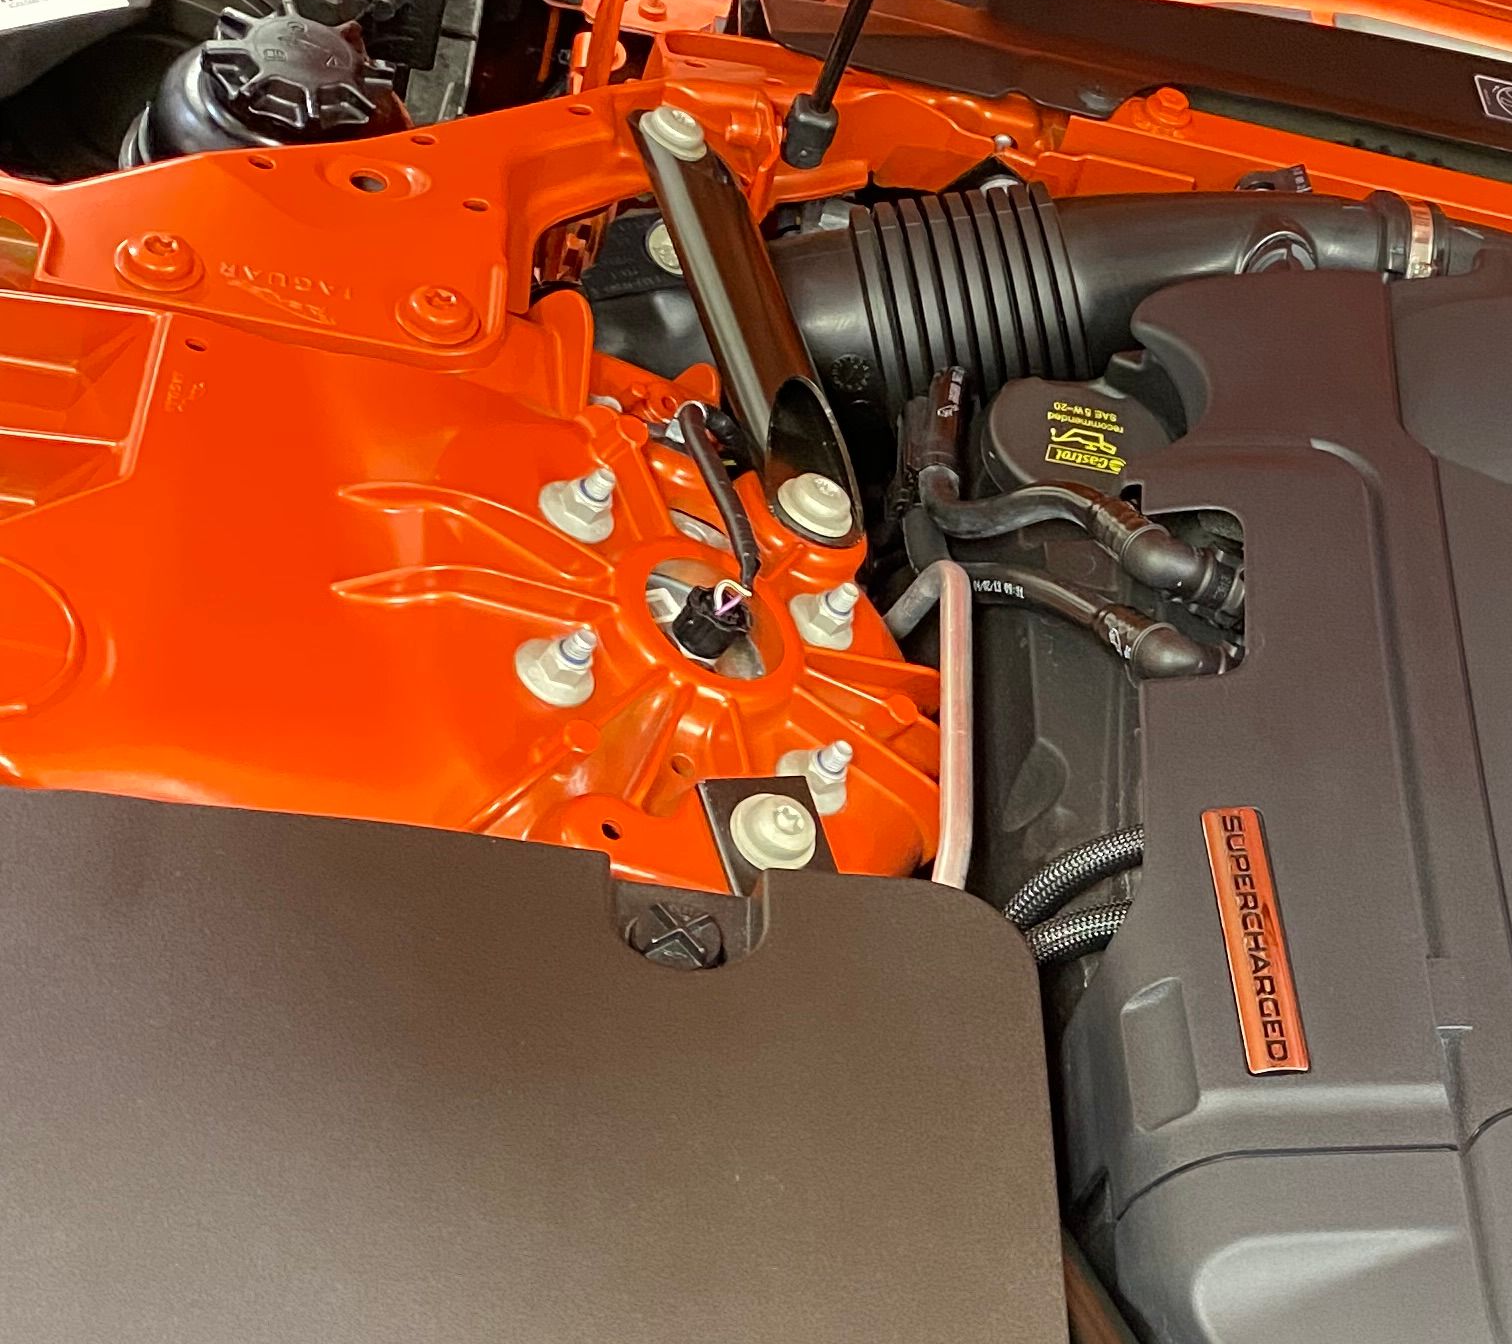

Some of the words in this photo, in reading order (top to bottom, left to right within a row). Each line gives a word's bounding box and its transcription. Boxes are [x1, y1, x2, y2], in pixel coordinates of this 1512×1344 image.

[1047, 411, 1124, 433] recommended
[1095, 410, 1117, 422] SAE
[1055, 449, 1108, 469] Castrol
[1222, 815, 1288, 1062] SUPERCHARGED
